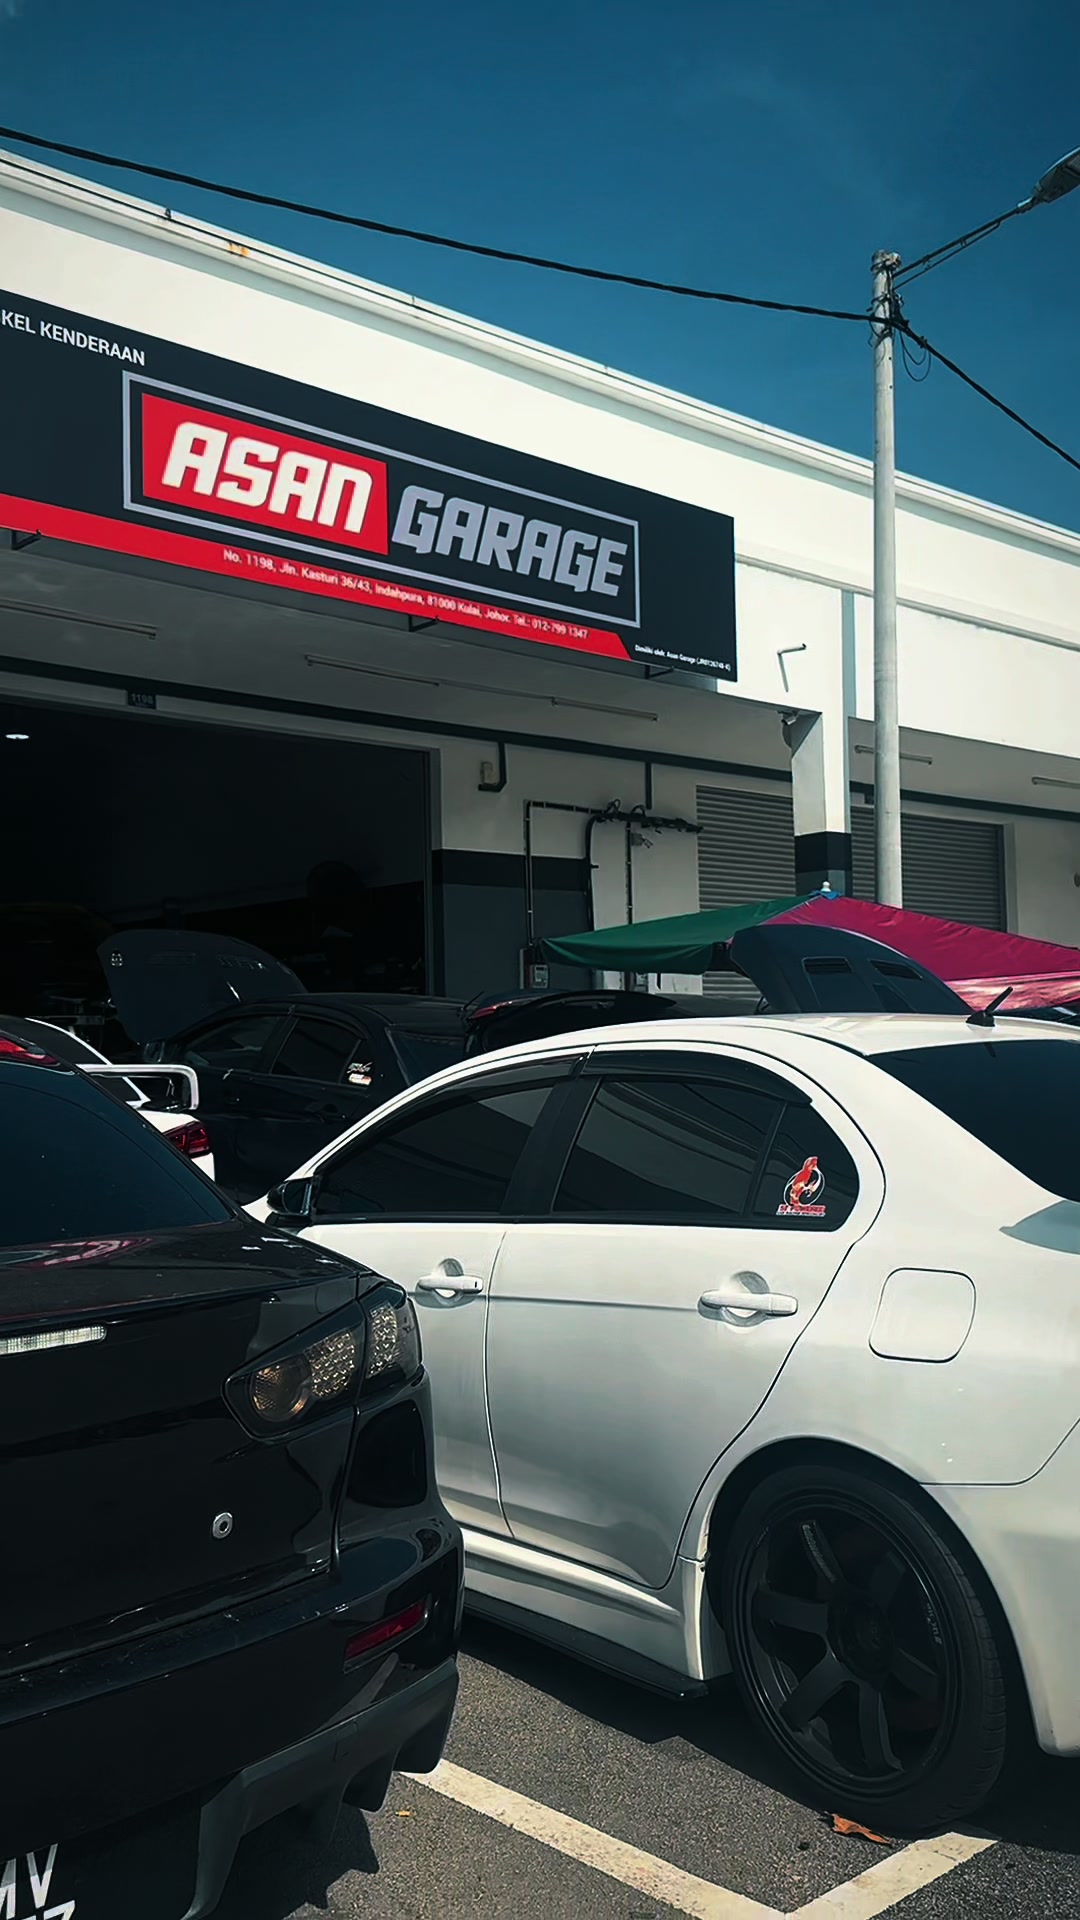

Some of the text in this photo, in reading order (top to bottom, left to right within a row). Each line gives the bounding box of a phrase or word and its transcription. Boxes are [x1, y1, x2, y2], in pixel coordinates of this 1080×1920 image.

[40, 320, 145, 366] KENDERAAN
[161, 421, 628, 597] ASAN GARAGE
[223, 548, 242, 564] No.
[246, 553, 276, 573] 1198,
[280, 561, 299, 577] Jln.
[301, 566, 339, 586] Kasturi
[341, 575, 373, 595] 36/43,
[375, 584, 425, 605] Indahpura,
[427, 594, 456, 611] 81000
[457, 602, 483, 618] Kulai,
[567, 625, 588, 639] 1347
